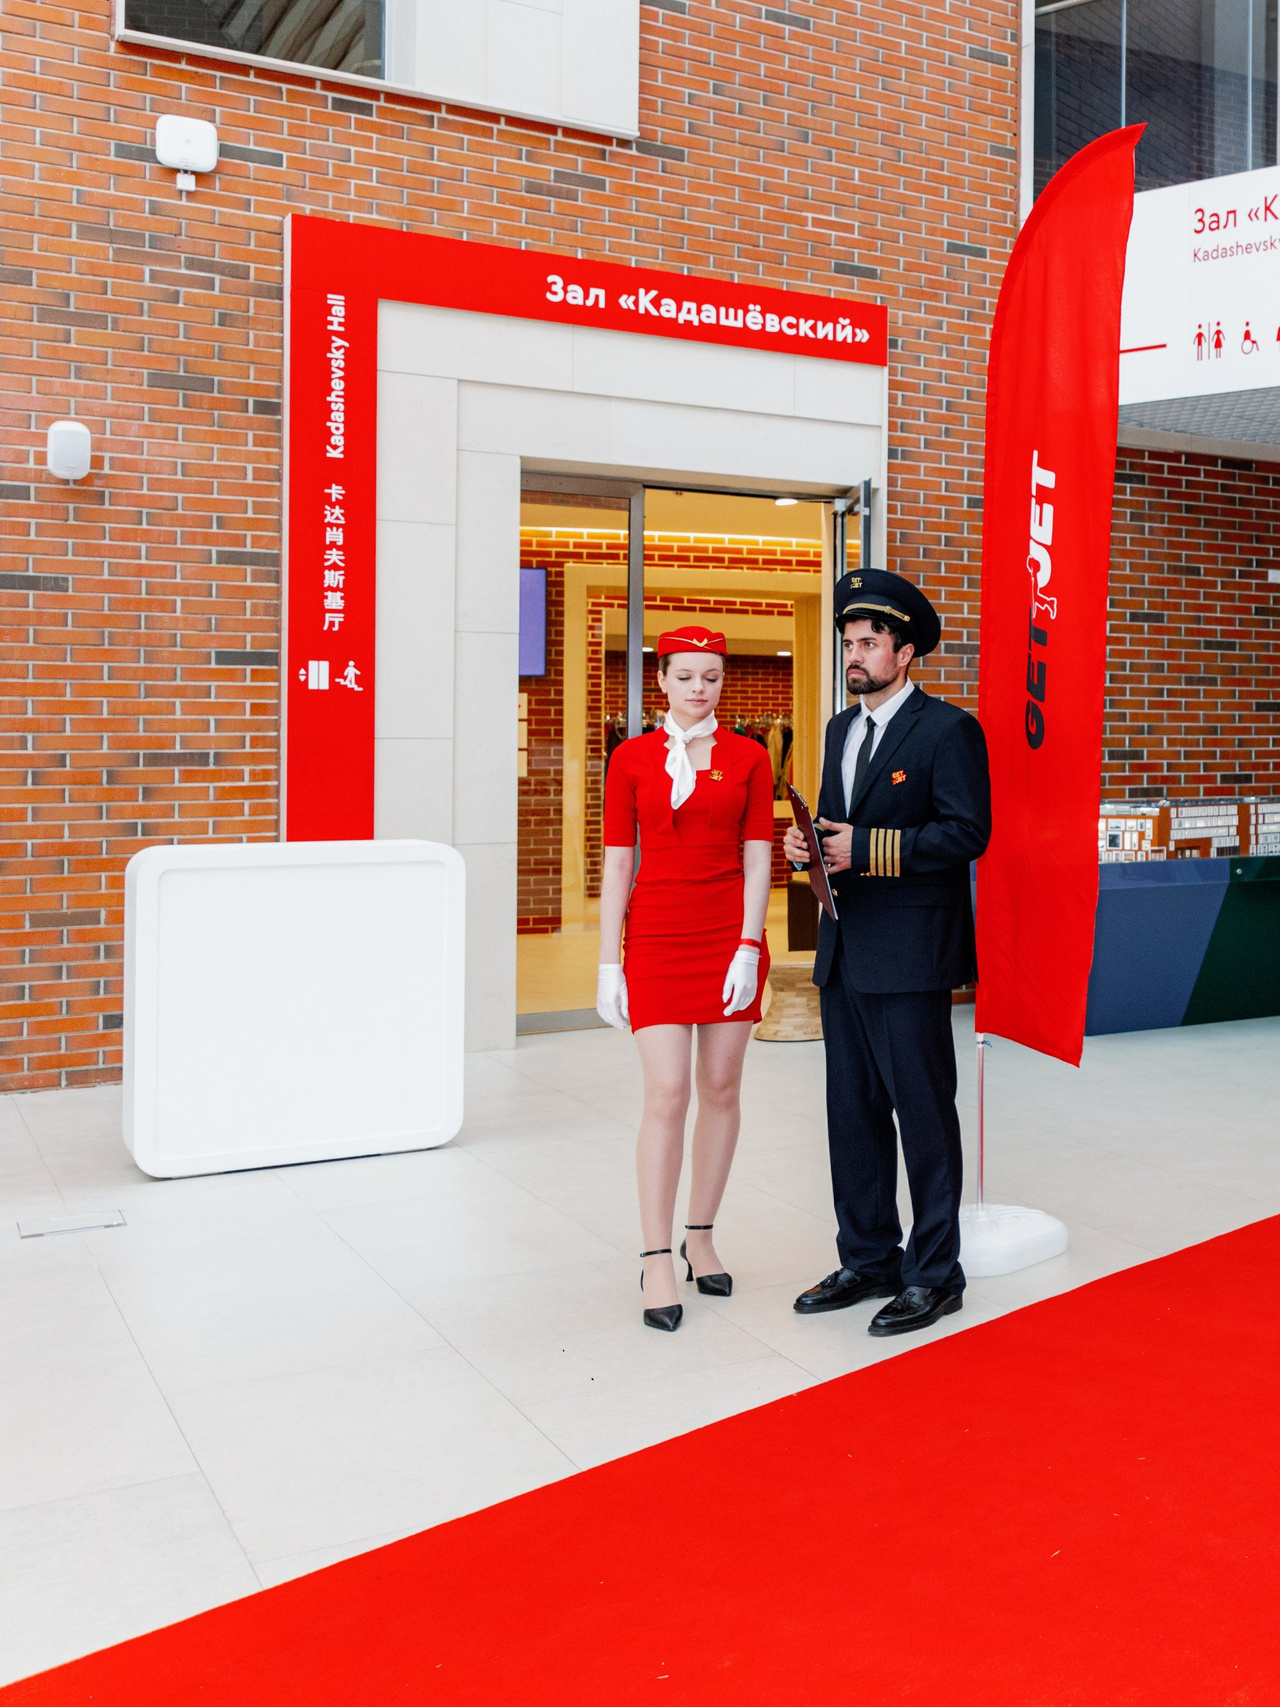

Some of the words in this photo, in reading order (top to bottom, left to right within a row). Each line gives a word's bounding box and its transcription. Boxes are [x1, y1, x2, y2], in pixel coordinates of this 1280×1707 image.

[1193, 207, 1238, 234] Зал
[326, 293, 346, 332] Hall
[545, 274, 606, 309] Зал
[618, 287, 870, 344] «Кадашёвский»
[326, 335, 350, 459] Kadashevsky
[323, 483, 346, 632] 卡达肖夫斯基厅
[1029, 449, 1056, 589] JET
[1025, 605, 1048, 750] GET
